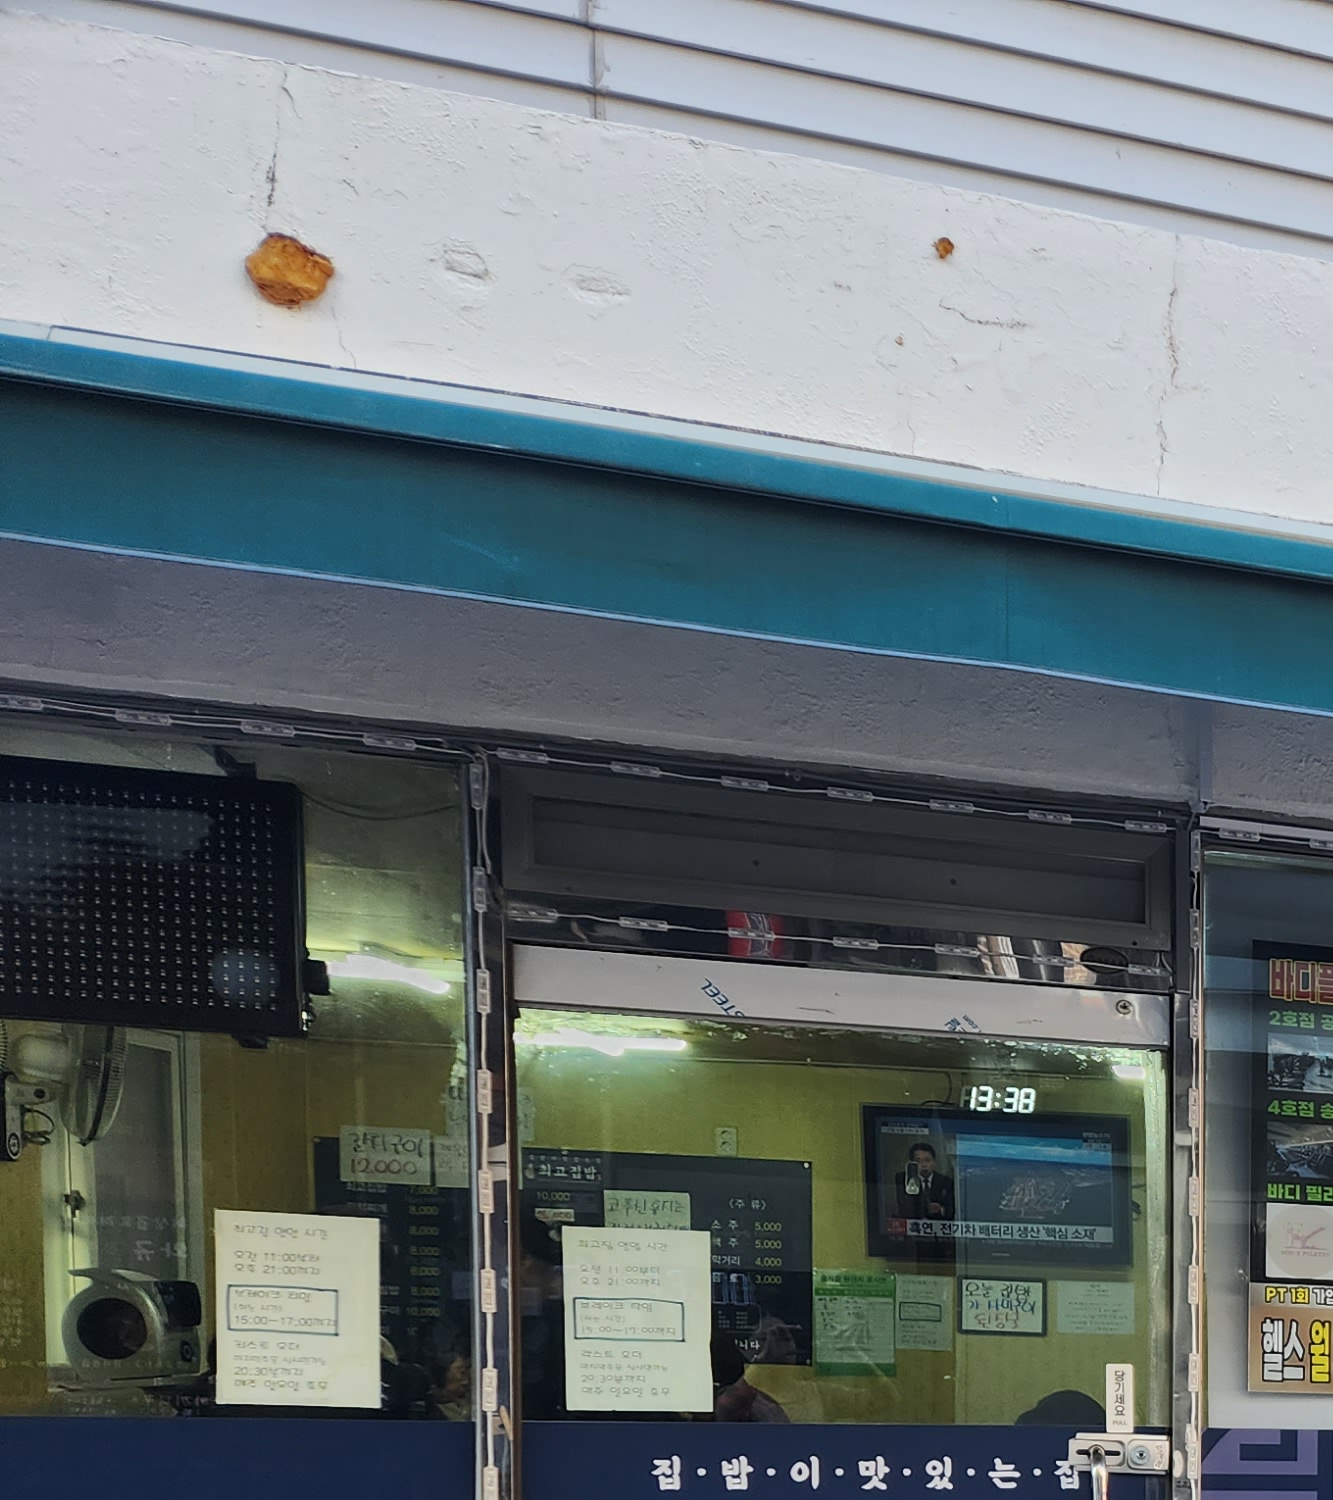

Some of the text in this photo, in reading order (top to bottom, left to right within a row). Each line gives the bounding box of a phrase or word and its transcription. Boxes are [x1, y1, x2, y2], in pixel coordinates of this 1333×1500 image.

[1269, 1010, 1315, 1029] 2호점
[969, 1085, 1036, 1114] 13:38
[1267, 1099, 1315, 1118] 4호점
[538, 1163, 597, 1180] 최고집밥
[1267, 1183, 1300, 1200] 바디
[909, 1221, 938, 1237] 흑연,
[939, 1222, 976, 1237] 전기차
[978, 1223, 1014, 1238] 배터리
[1016, 1225, 1040, 1239] 생산
[1266, 1287, 1287, 1303] PT
[1290, 1287, 1310, 1304] 1회
[1261, 1318, 1305, 1381] 헬스
[1310, 1319, 1331, 1383] 월
[1114, 1370, 1126, 1417] 당기세요
